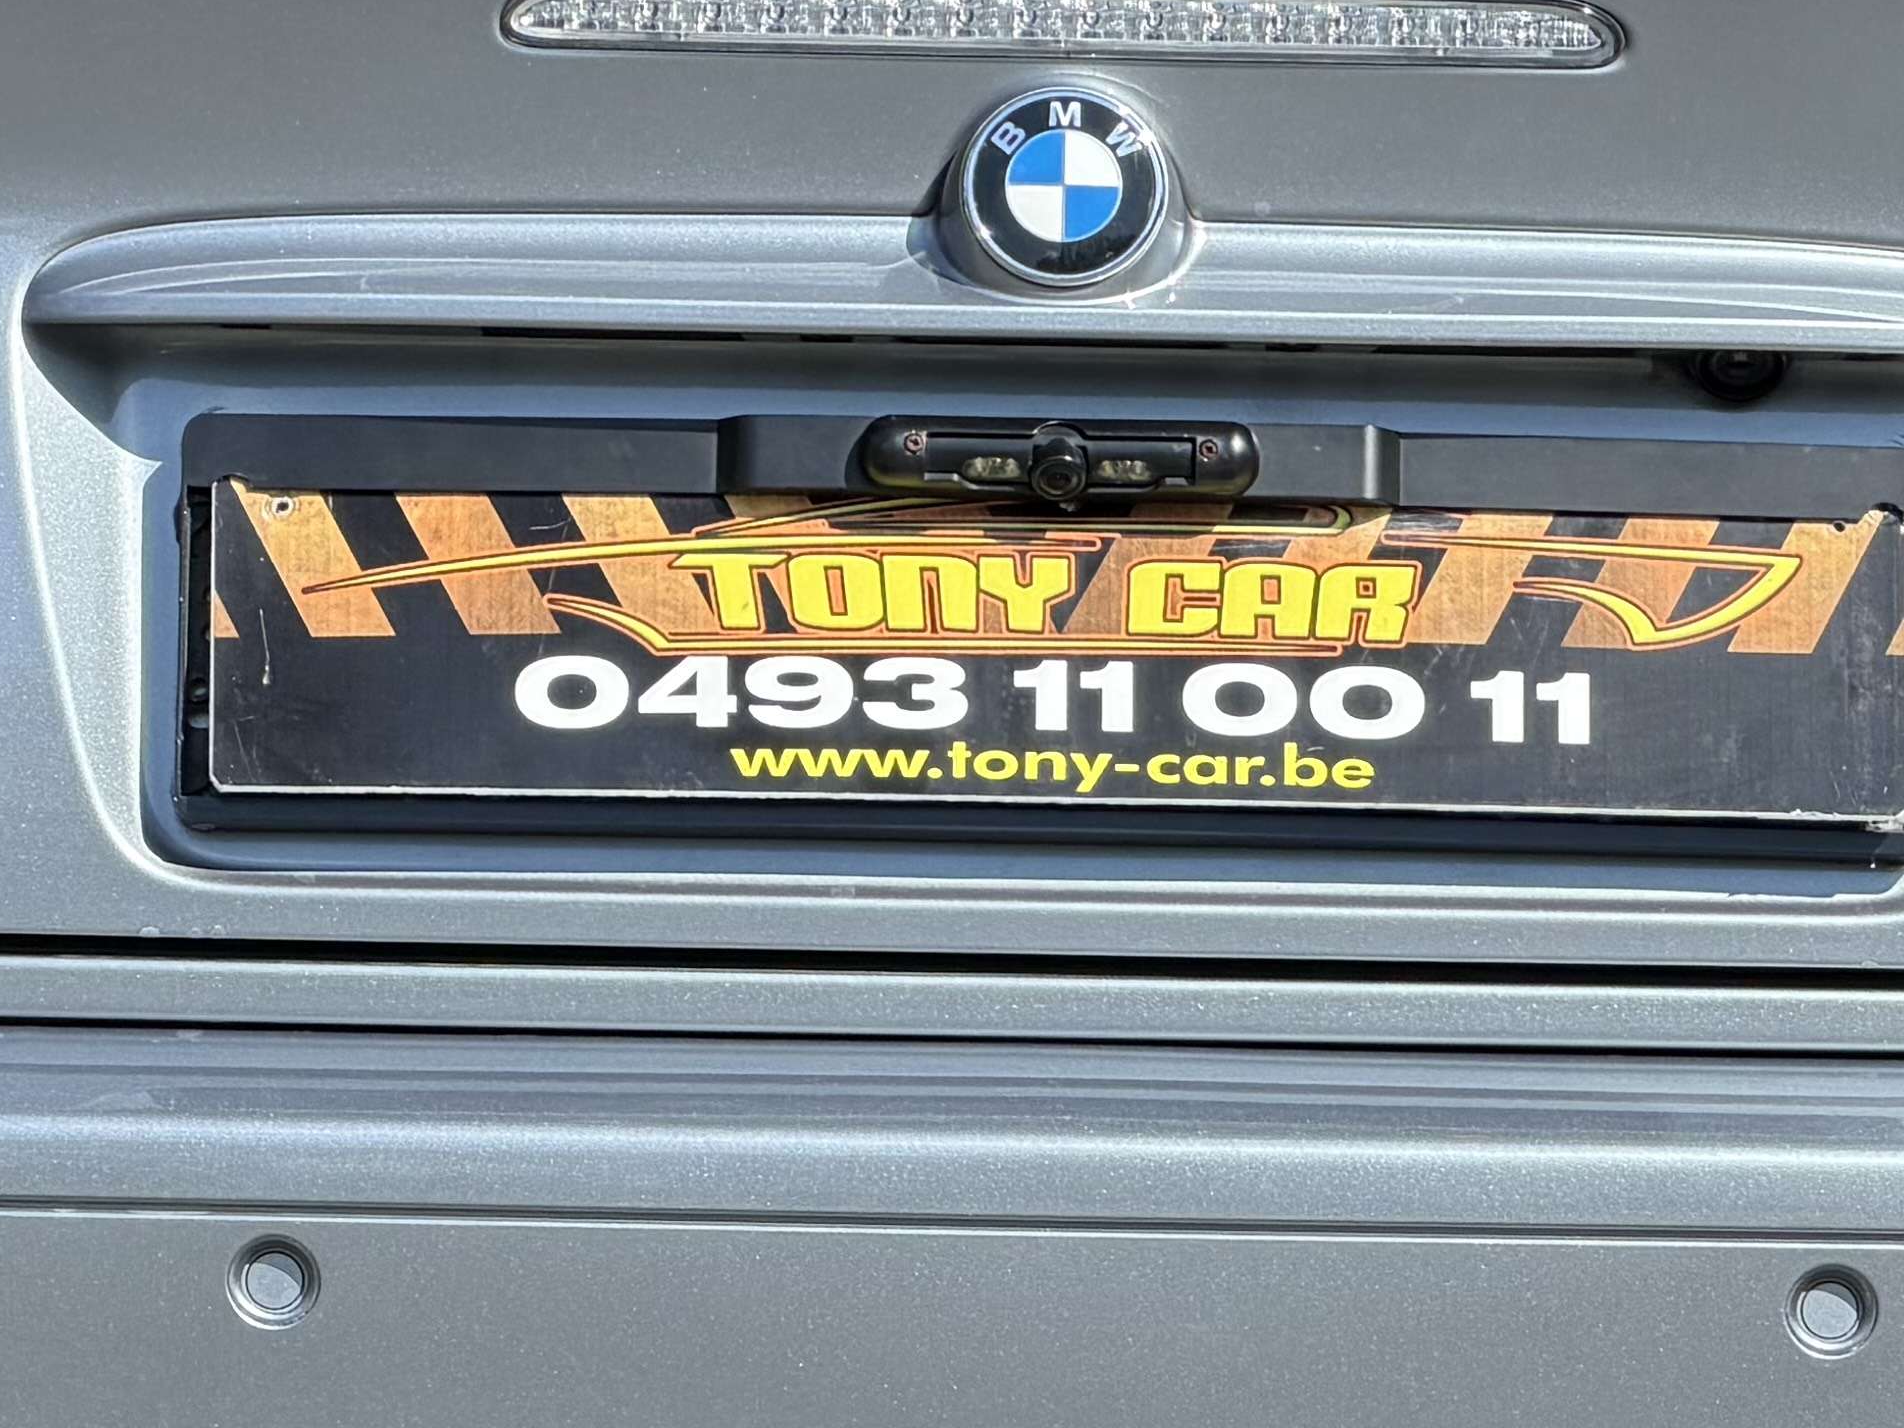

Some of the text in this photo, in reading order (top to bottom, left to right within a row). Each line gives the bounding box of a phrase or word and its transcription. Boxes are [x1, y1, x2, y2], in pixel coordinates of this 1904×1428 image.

[989, 100, 1143, 158] BMW
[669, 551, 1416, 642] TONY CAR
[514, 654, 1591, 745] 0493 11 00 11
[730, 741, 1375, 794] www.tony-car.be
